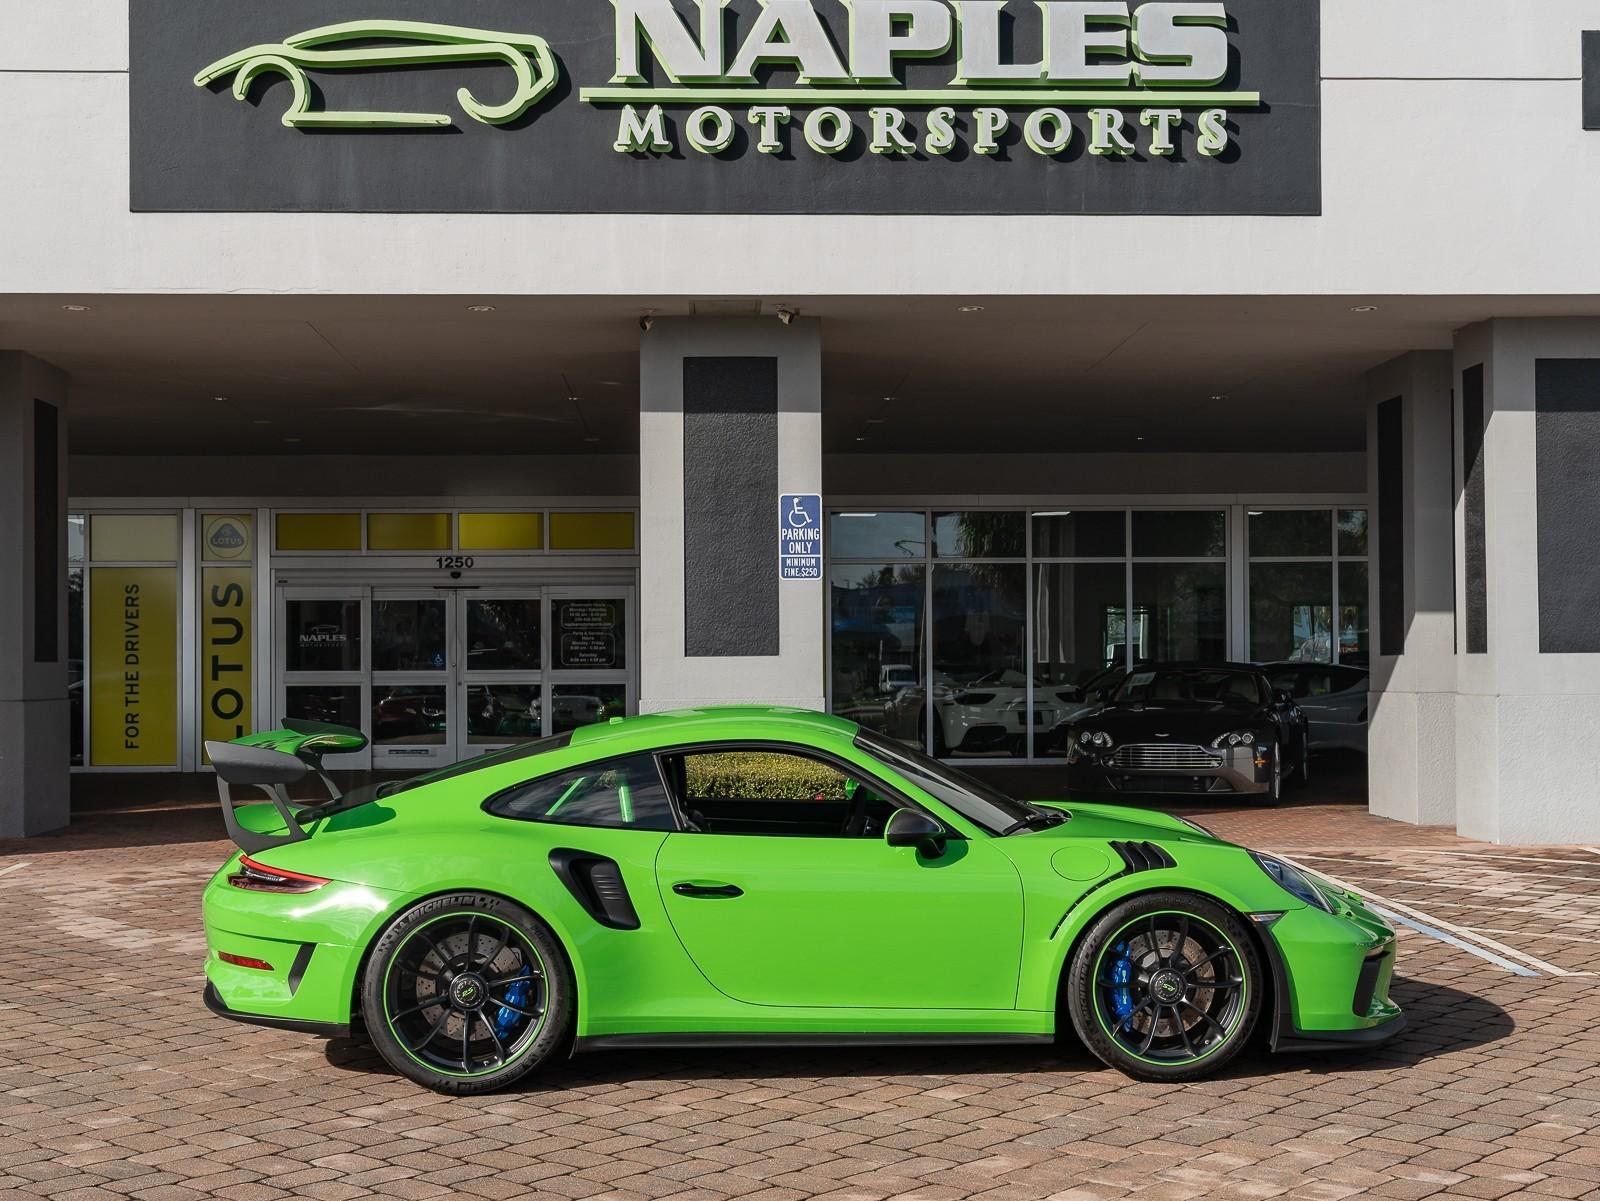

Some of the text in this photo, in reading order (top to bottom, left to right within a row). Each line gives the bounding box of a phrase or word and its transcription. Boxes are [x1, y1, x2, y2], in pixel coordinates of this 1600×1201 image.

[608, 0, 1228, 87] NAPLES
[613, 104, 1228, 156] MOTORSPORTS
[212, 537, 242, 545] LOTUS
[781, 528, 820, 541] PARKING
[788, 541, 813, 554] ONLY
[436, 556, 474, 569] 1250
[786, 557, 816, 567] MINIMUM
[784, 567, 818, 578] FINE $250
[299, 634, 347, 642] NAPLES
[124, 583, 140, 749] FOR THE DRIVERS
[408, 896, 475, 922] MICHELIN
